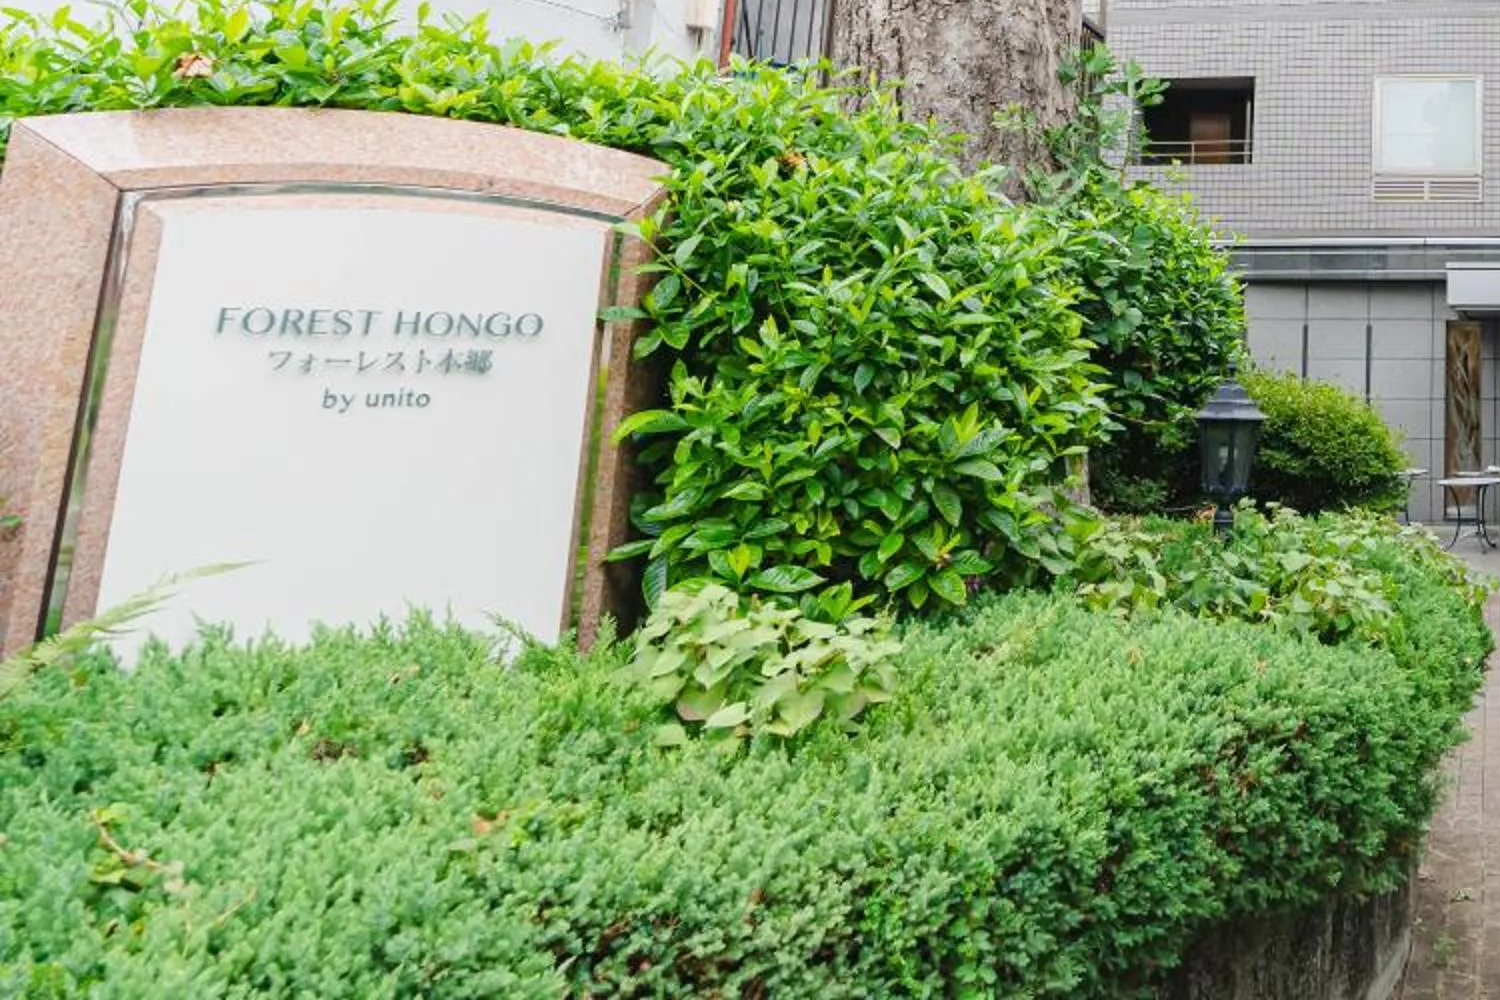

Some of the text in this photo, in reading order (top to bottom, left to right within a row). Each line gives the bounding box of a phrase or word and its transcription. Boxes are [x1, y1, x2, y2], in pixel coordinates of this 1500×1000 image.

[215, 307, 545, 338] FOREST HONGO
[268, 349, 494, 375] フォーレスト本郷
[321, 388, 432, 413] by unito
